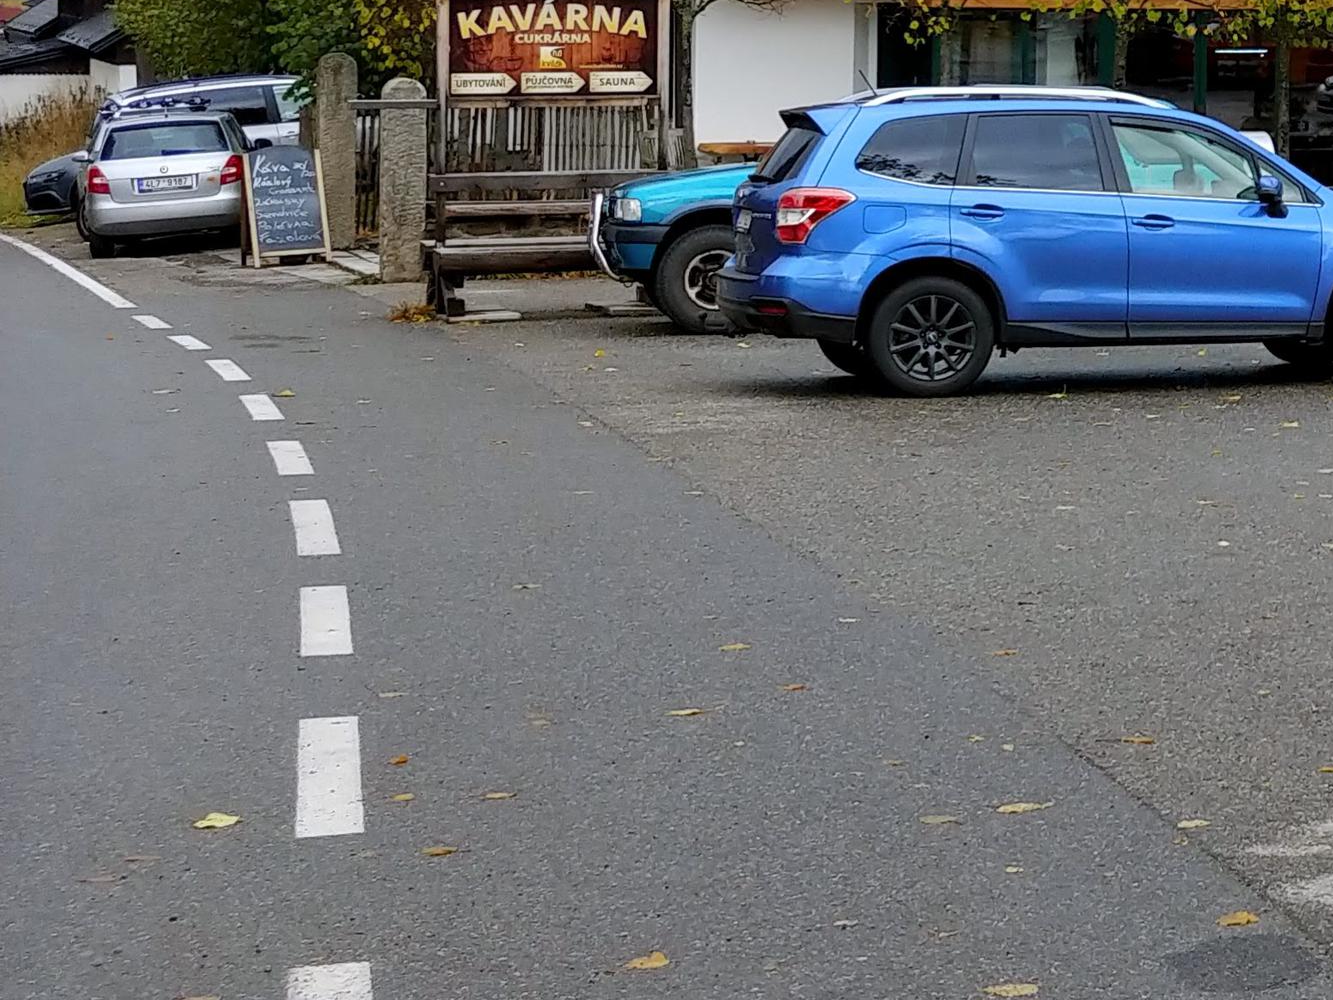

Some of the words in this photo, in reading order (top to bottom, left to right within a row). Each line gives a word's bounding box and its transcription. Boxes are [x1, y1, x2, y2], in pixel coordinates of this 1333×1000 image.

[514, 31, 591, 44] CUKRÁRNA
[455, 73, 507, 88] UBYTOVÁNÍ
[525, 75, 574, 85] PŮJČOVNA
[599, 77, 636, 87] SAUNA
[253, 154, 290, 178] Káva
